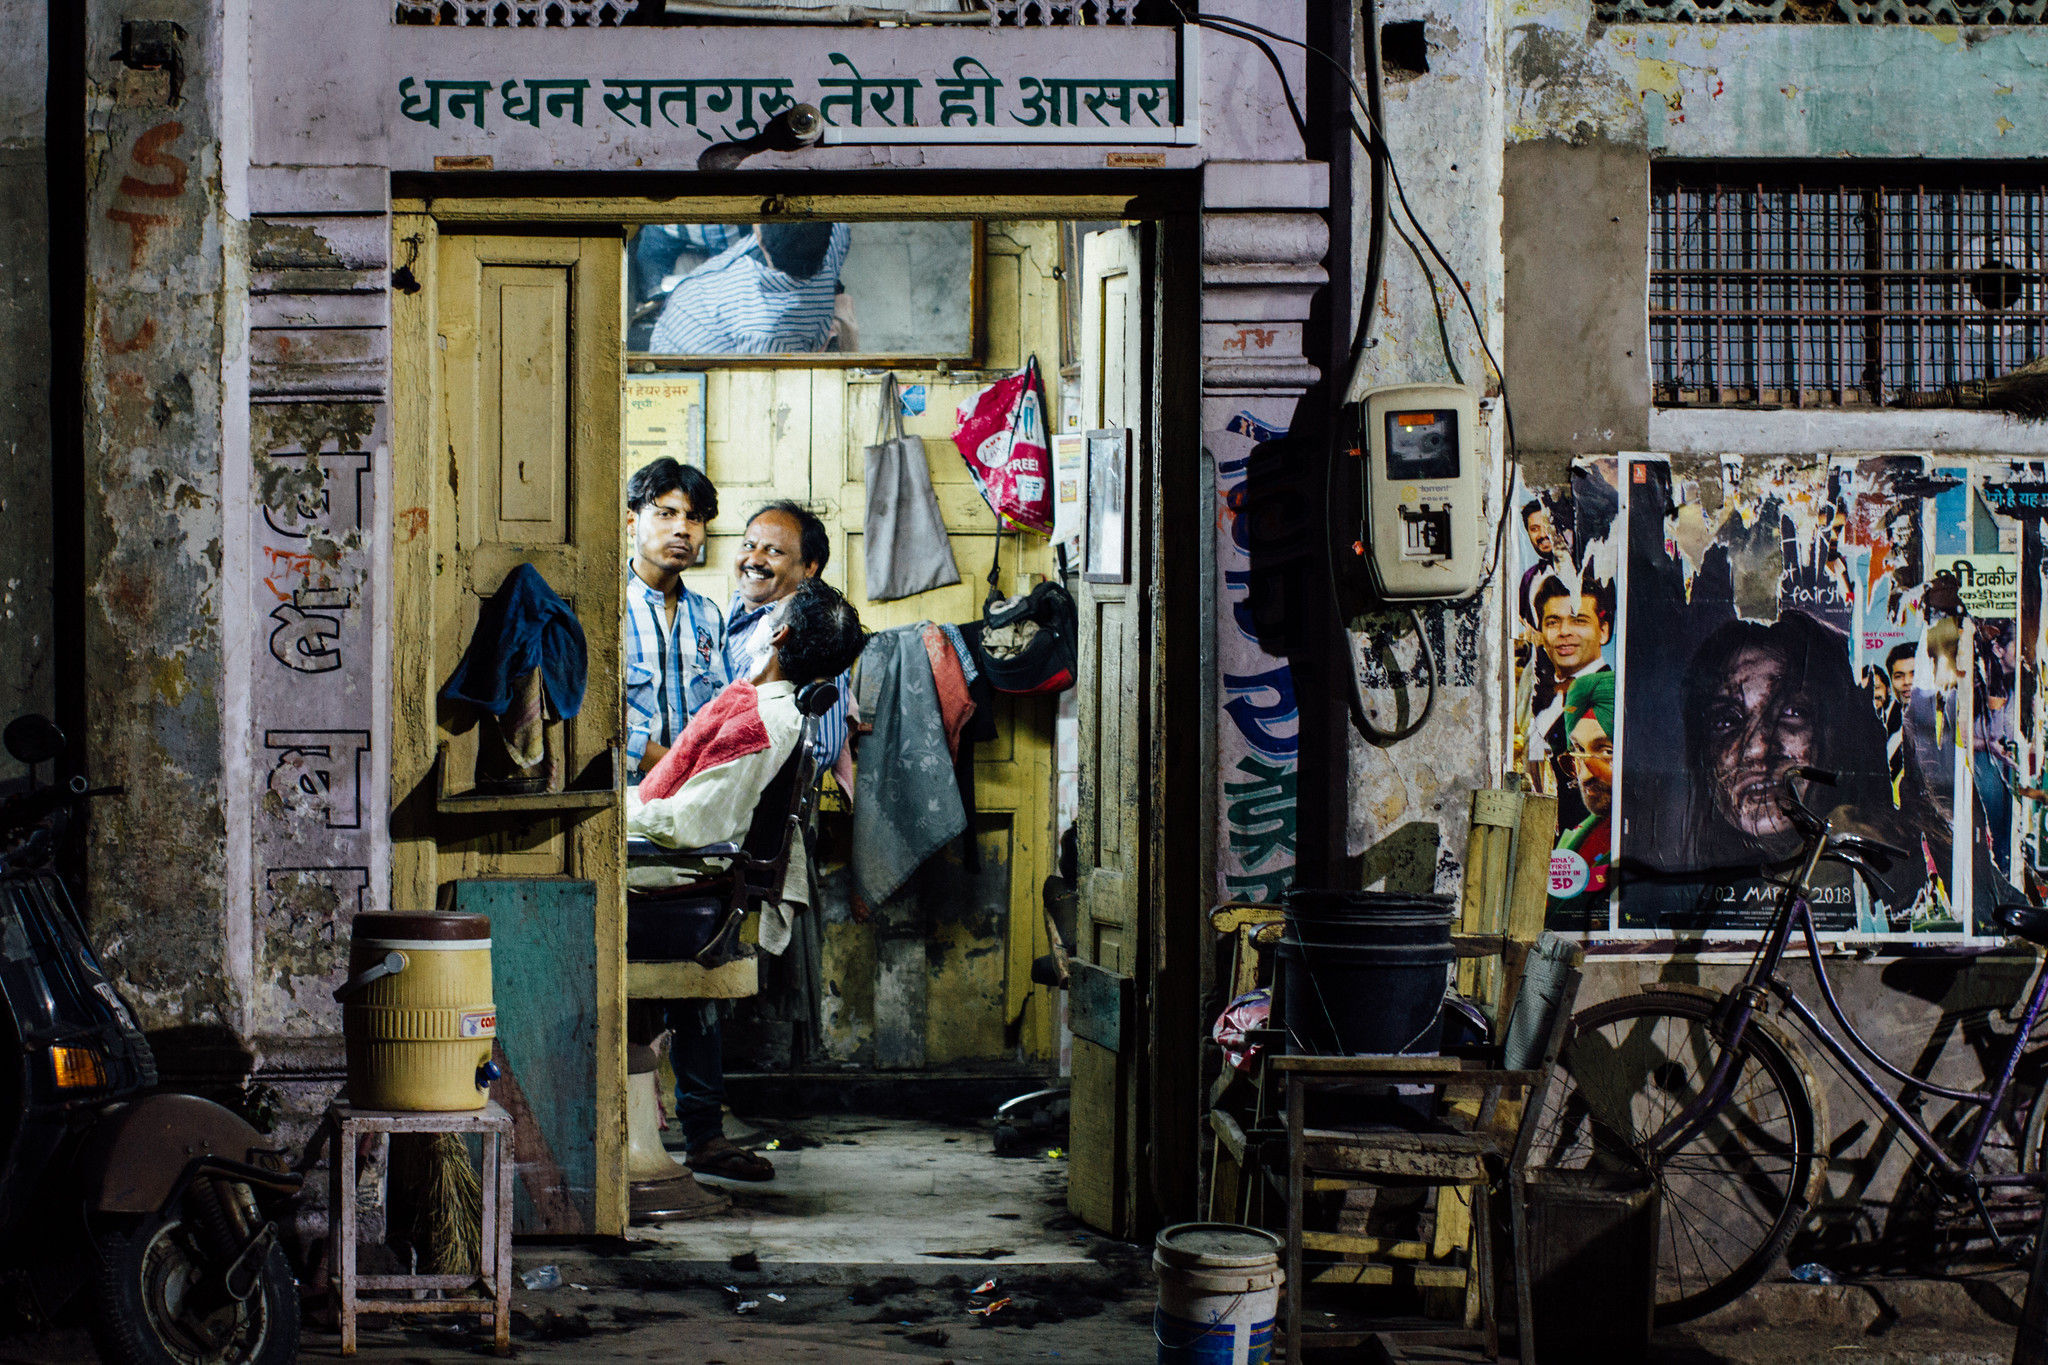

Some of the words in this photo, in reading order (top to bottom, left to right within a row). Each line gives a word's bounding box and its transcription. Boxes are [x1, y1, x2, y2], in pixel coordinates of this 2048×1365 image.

[399, 76, 493, 130] धन
[500, 79, 591, 129] धन
[817, 52, 923, 128] तेरा
[935, 55, 1004, 128] ही
[1009, 76, 1176, 128] आसरा
[1865, 638, 1884, 650] 3D
[1551, 877, 1574, 891] 3D
[1715, 886, 1737, 902] 02
[1811, 886, 1851, 904] 2018
